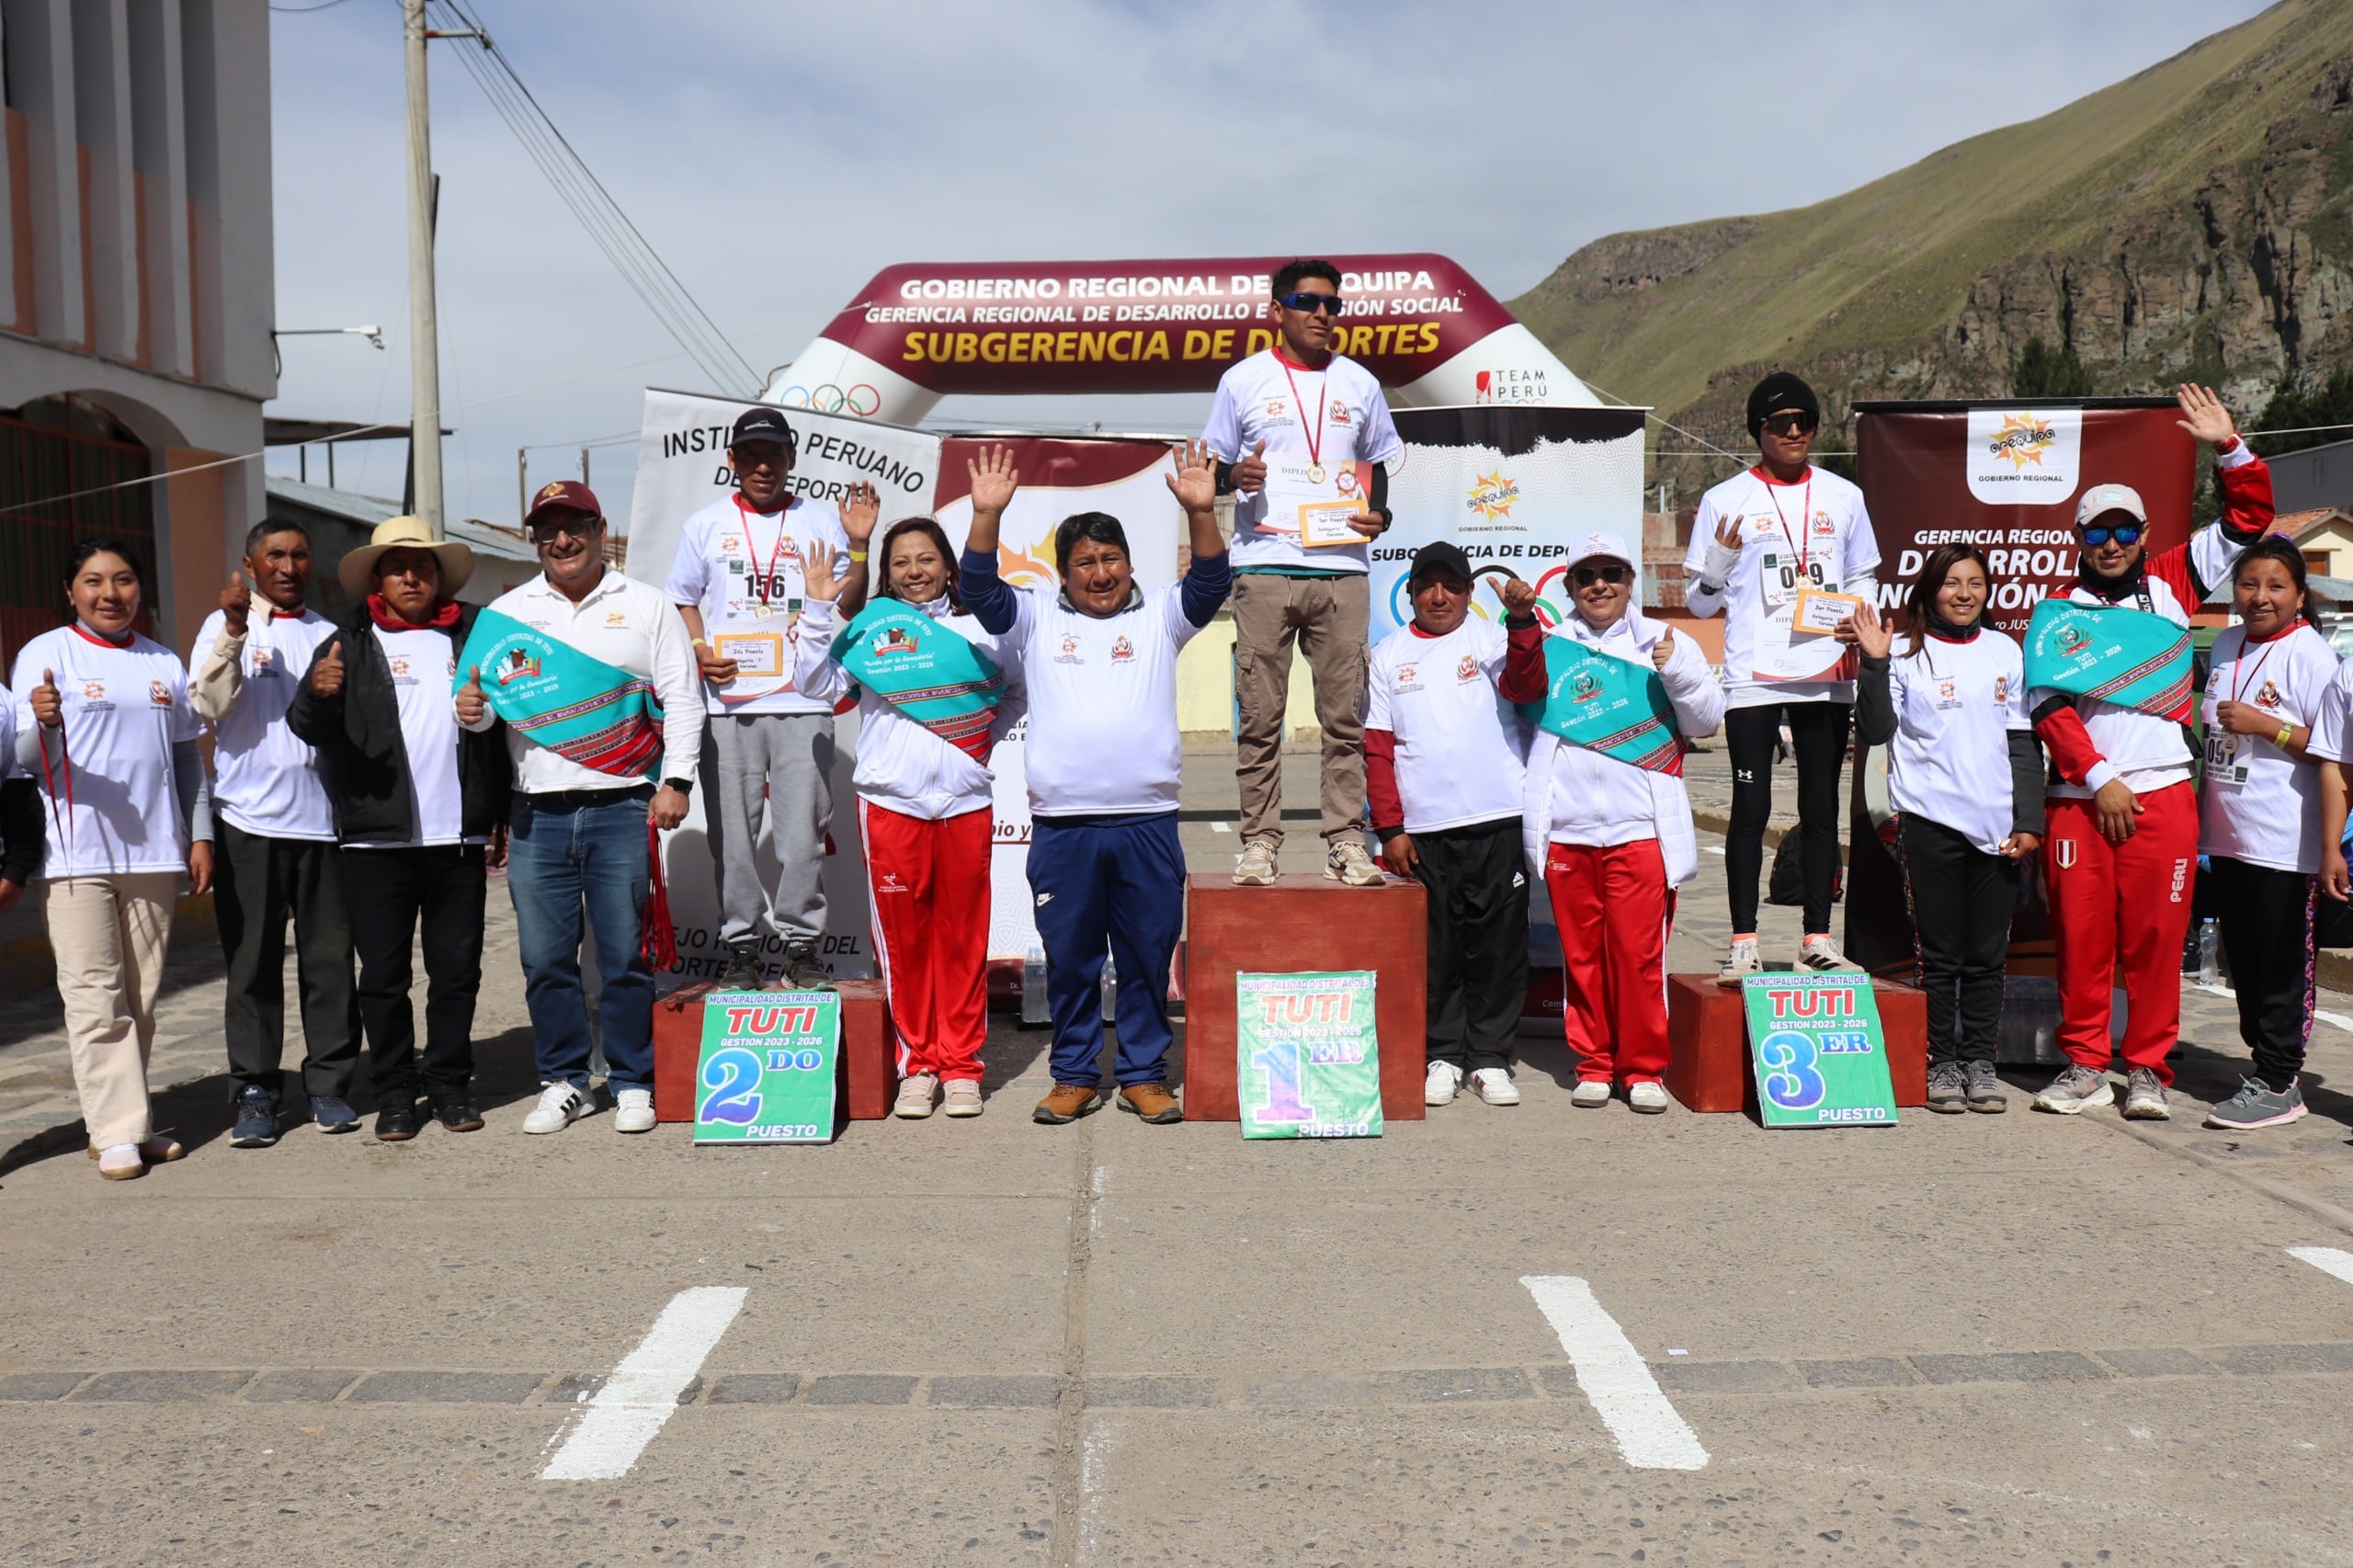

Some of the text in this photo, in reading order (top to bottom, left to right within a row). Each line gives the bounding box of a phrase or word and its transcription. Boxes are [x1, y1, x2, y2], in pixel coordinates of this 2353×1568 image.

[901, 270, 1435, 300] GOBIERNO REGIONAL DE QUIPA
[865, 305, 967, 324] GERENCIA
[972, 303, 1077, 324] REGIONAL
[1083, 304, 1109, 322] DE
[1115, 301, 1250, 322] DESARROLLO
[1255, 302, 1268, 319] E
[1390, 297, 1464, 316] SOCIAL
[903, 329, 1170, 362] SUBGERENCIA
[1183, 328, 1235, 359] DE
[1495, 369, 1546, 382] TEAM
[1498, 381, 1548, 398] PERÚ
[805, 432, 924, 493] PERUANO
[1978, 474, 2063, 483] GOBIERNO REGIONAL
[1914, 528, 2075, 545] GERENCIA REGION
[1499, 545, 1524, 557] DE
[744, 574, 785, 598] 156
[2169, 858, 2188, 903] PERU
[823, 935, 860, 955] DEL
[1240, 980, 1308, 991] MUNICIPALIDAD
[1309, 979, 1353, 990] DISTRITAL
[1746, 976, 1811, 987] MUNICIPALIDAD
[1812, 975, 1853, 986] DISTRITAL
[709, 994, 775, 1005] MUNICIPALIDAD
[776, 994, 819, 1004] DISTRITAL
[1767, 989, 1855, 1018] TUTI
[1260, 993, 1353, 1025] TUTI
[726, 1006, 817, 1035] TUTI
[1769, 1019, 1811, 1029] GESTION
[1812, 1019, 1836, 1029] 2023
[1843, 1018, 1868, 1028] 2026
[1259, 1028, 1302, 1039] GESTION
[1302, 1027, 1328, 1038] 2023
[1336, 1026, 1362, 1037] 2026
[721, 1037, 763, 1047] GESTION
[764, 1037, 789, 1047] 2023
[797, 1037, 823, 1046] 2026
[1760, 1030, 1873, 1110] 3 ER
[699, 1047, 823, 1126] 2 DO
[1250, 1040, 1365, 1124] 1 ER
[1818, 1107, 1886, 1121] PUESTO
[745, 1124, 818, 1138] PUESTO
[1298, 1123, 1370, 1138] PUESTO
